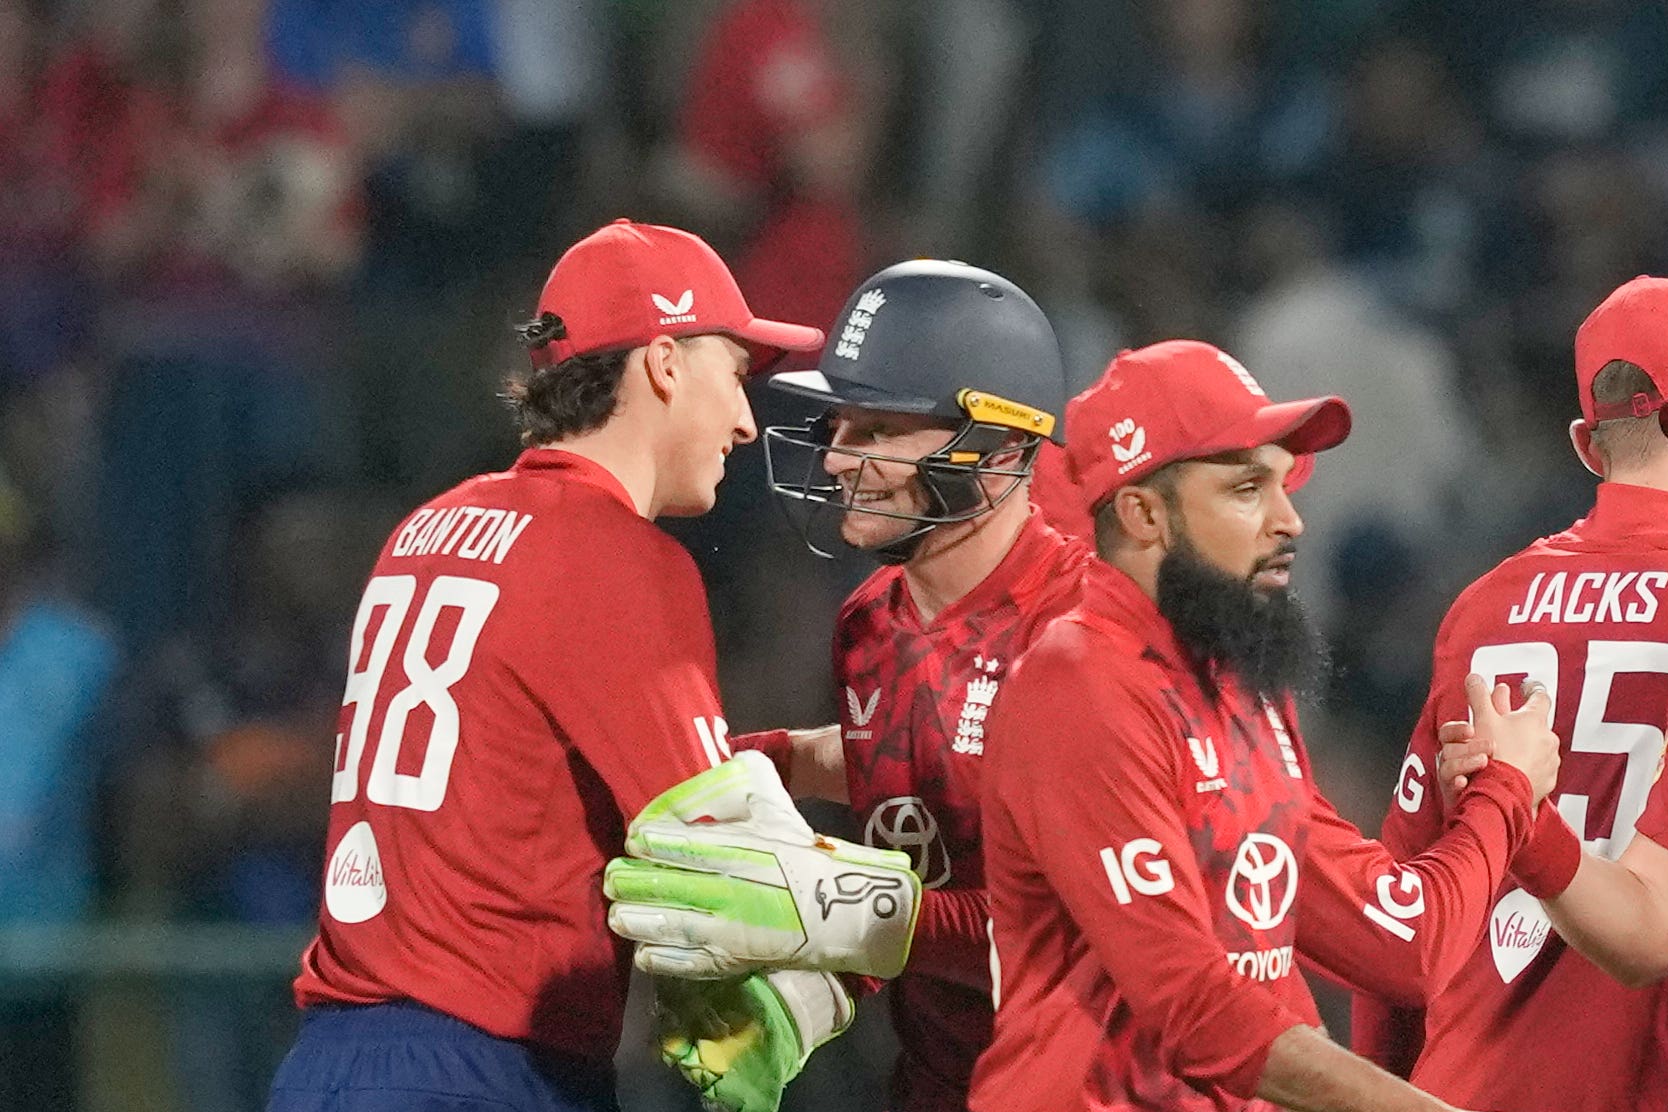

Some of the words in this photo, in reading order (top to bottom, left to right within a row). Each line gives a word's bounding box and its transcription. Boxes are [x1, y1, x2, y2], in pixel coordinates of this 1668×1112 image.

[1108, 417, 1136, 443] 100
[392, 506, 533, 564] BANTON
[1100, 838, 1175, 904] IG
[1363, 869, 1426, 943] IG
